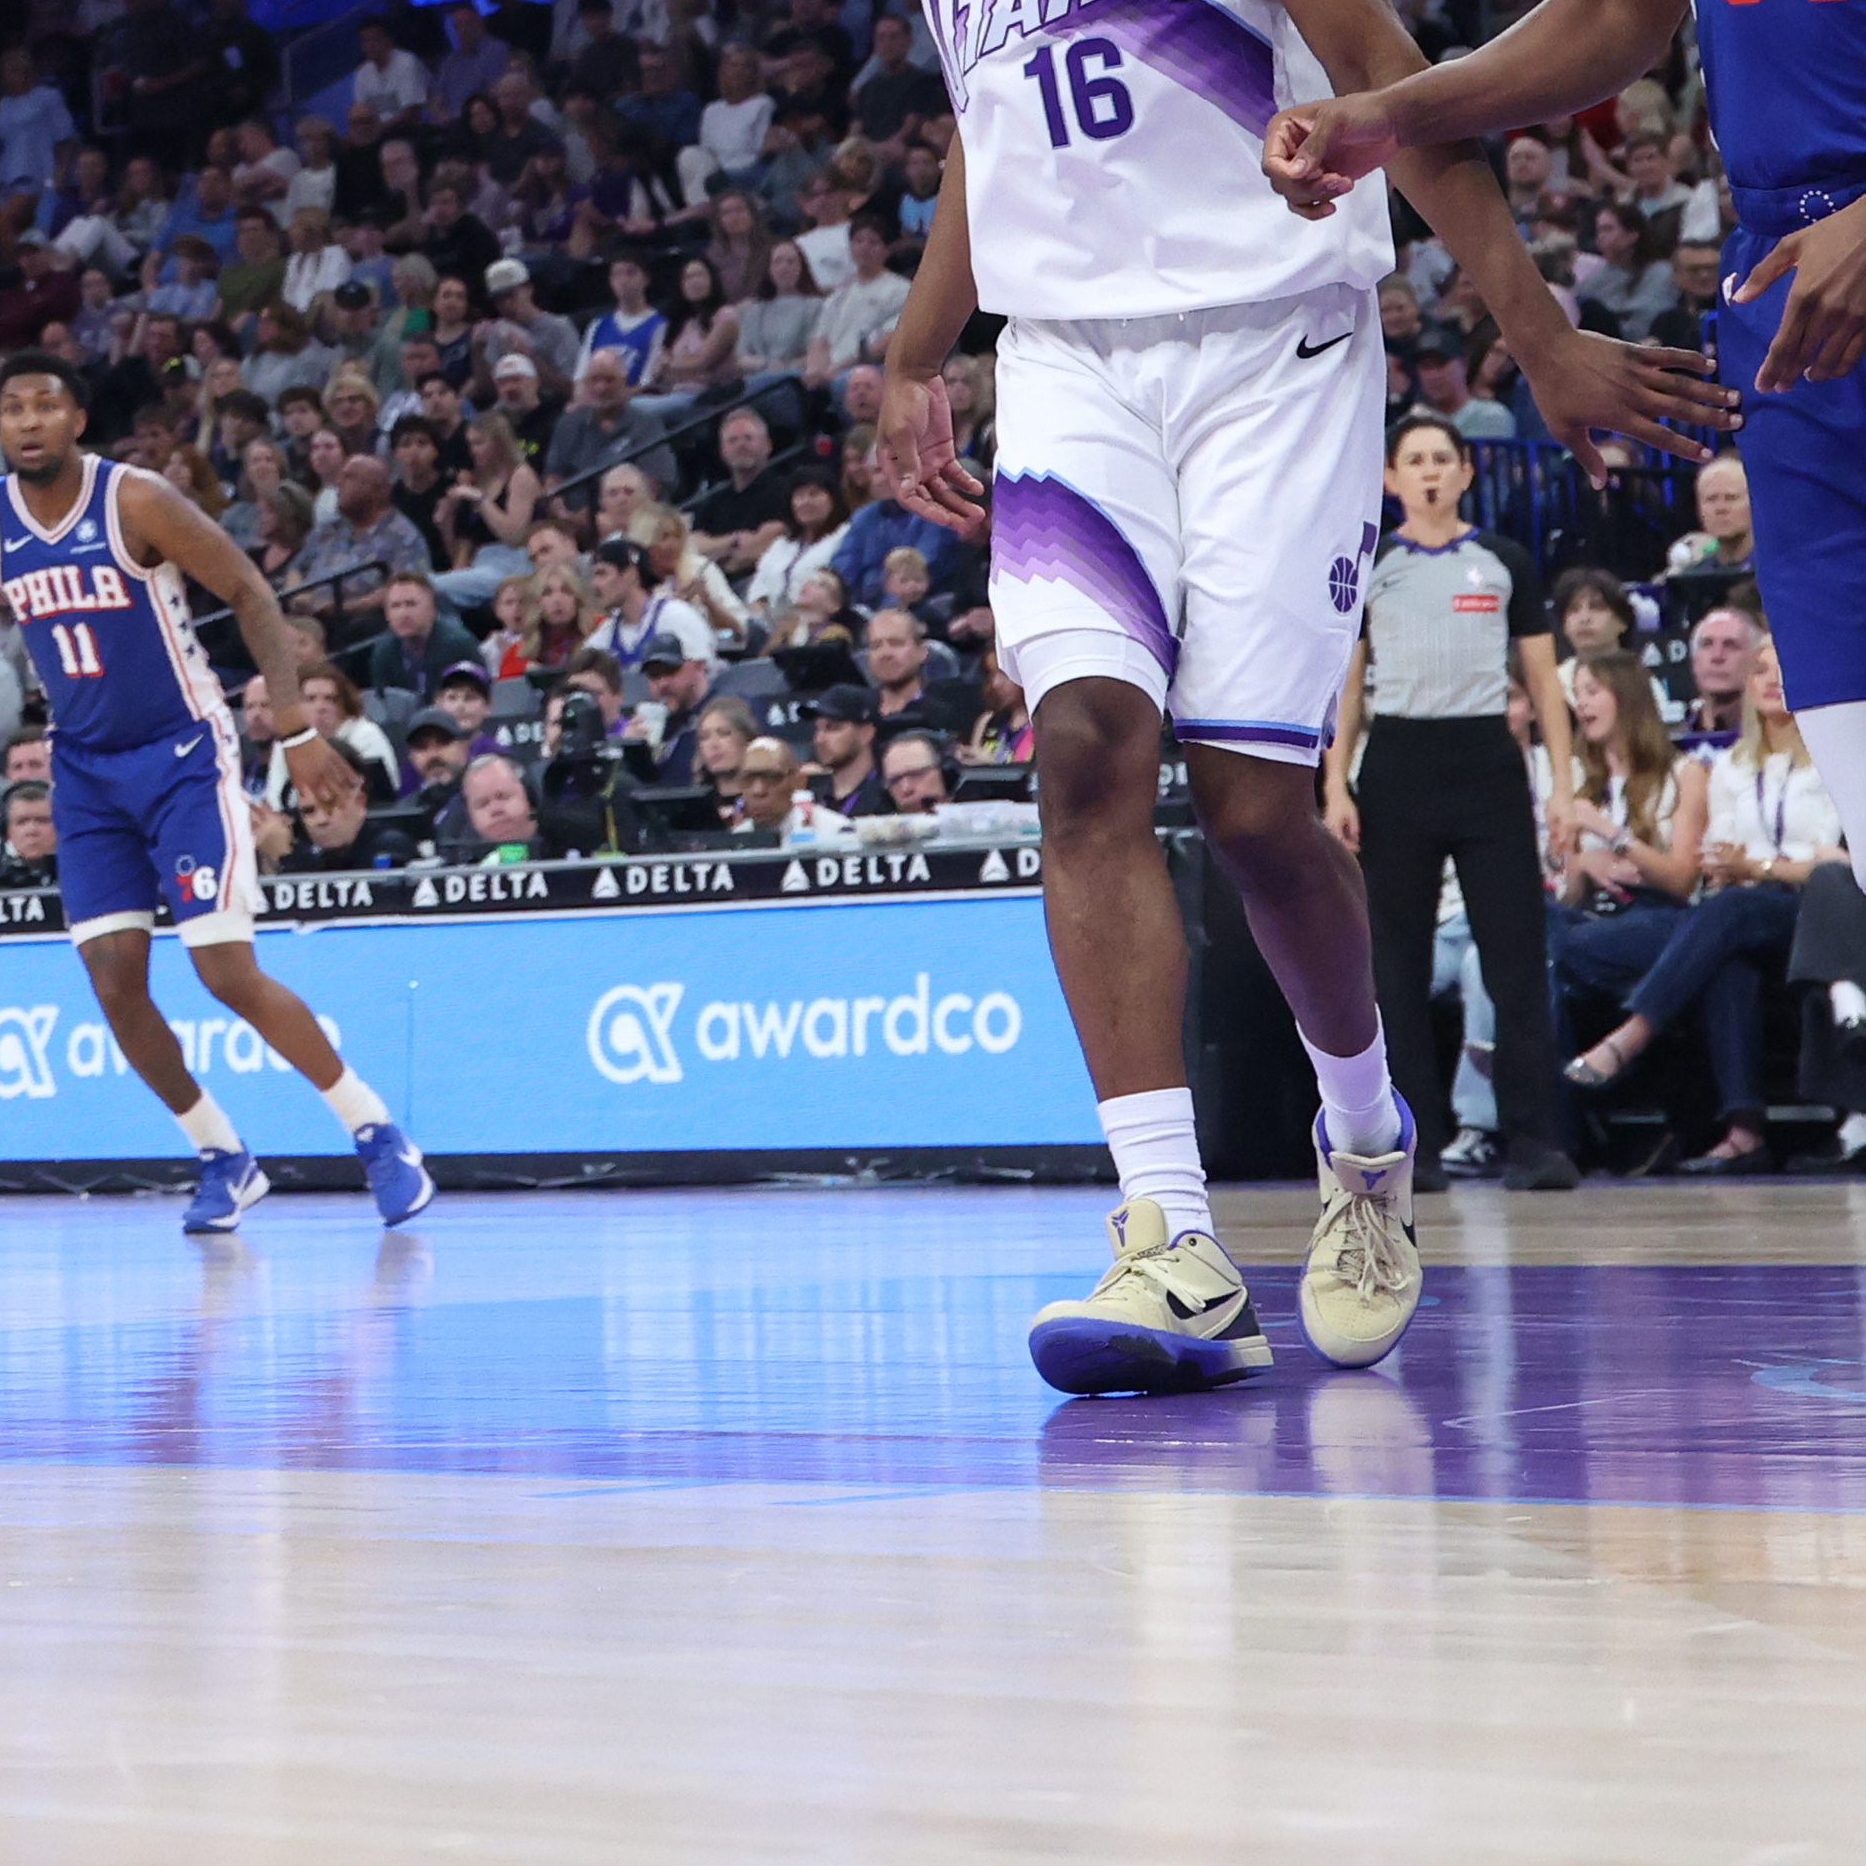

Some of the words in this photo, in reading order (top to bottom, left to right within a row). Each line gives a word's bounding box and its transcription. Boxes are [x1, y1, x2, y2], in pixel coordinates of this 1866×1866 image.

[1023, 36, 1135, 149] 16
[2, 565, 134, 624] PHILA
[51, 621, 105, 678] 11
[175, 866, 218, 902] 76
[445, 870, 549, 903] DELTA
[625, 862, 735, 895] DELTA
[816, 852, 932, 888] DELTA
[274, 878, 374, 910] DELTA
[696, 971, 1022, 1062] awardco
